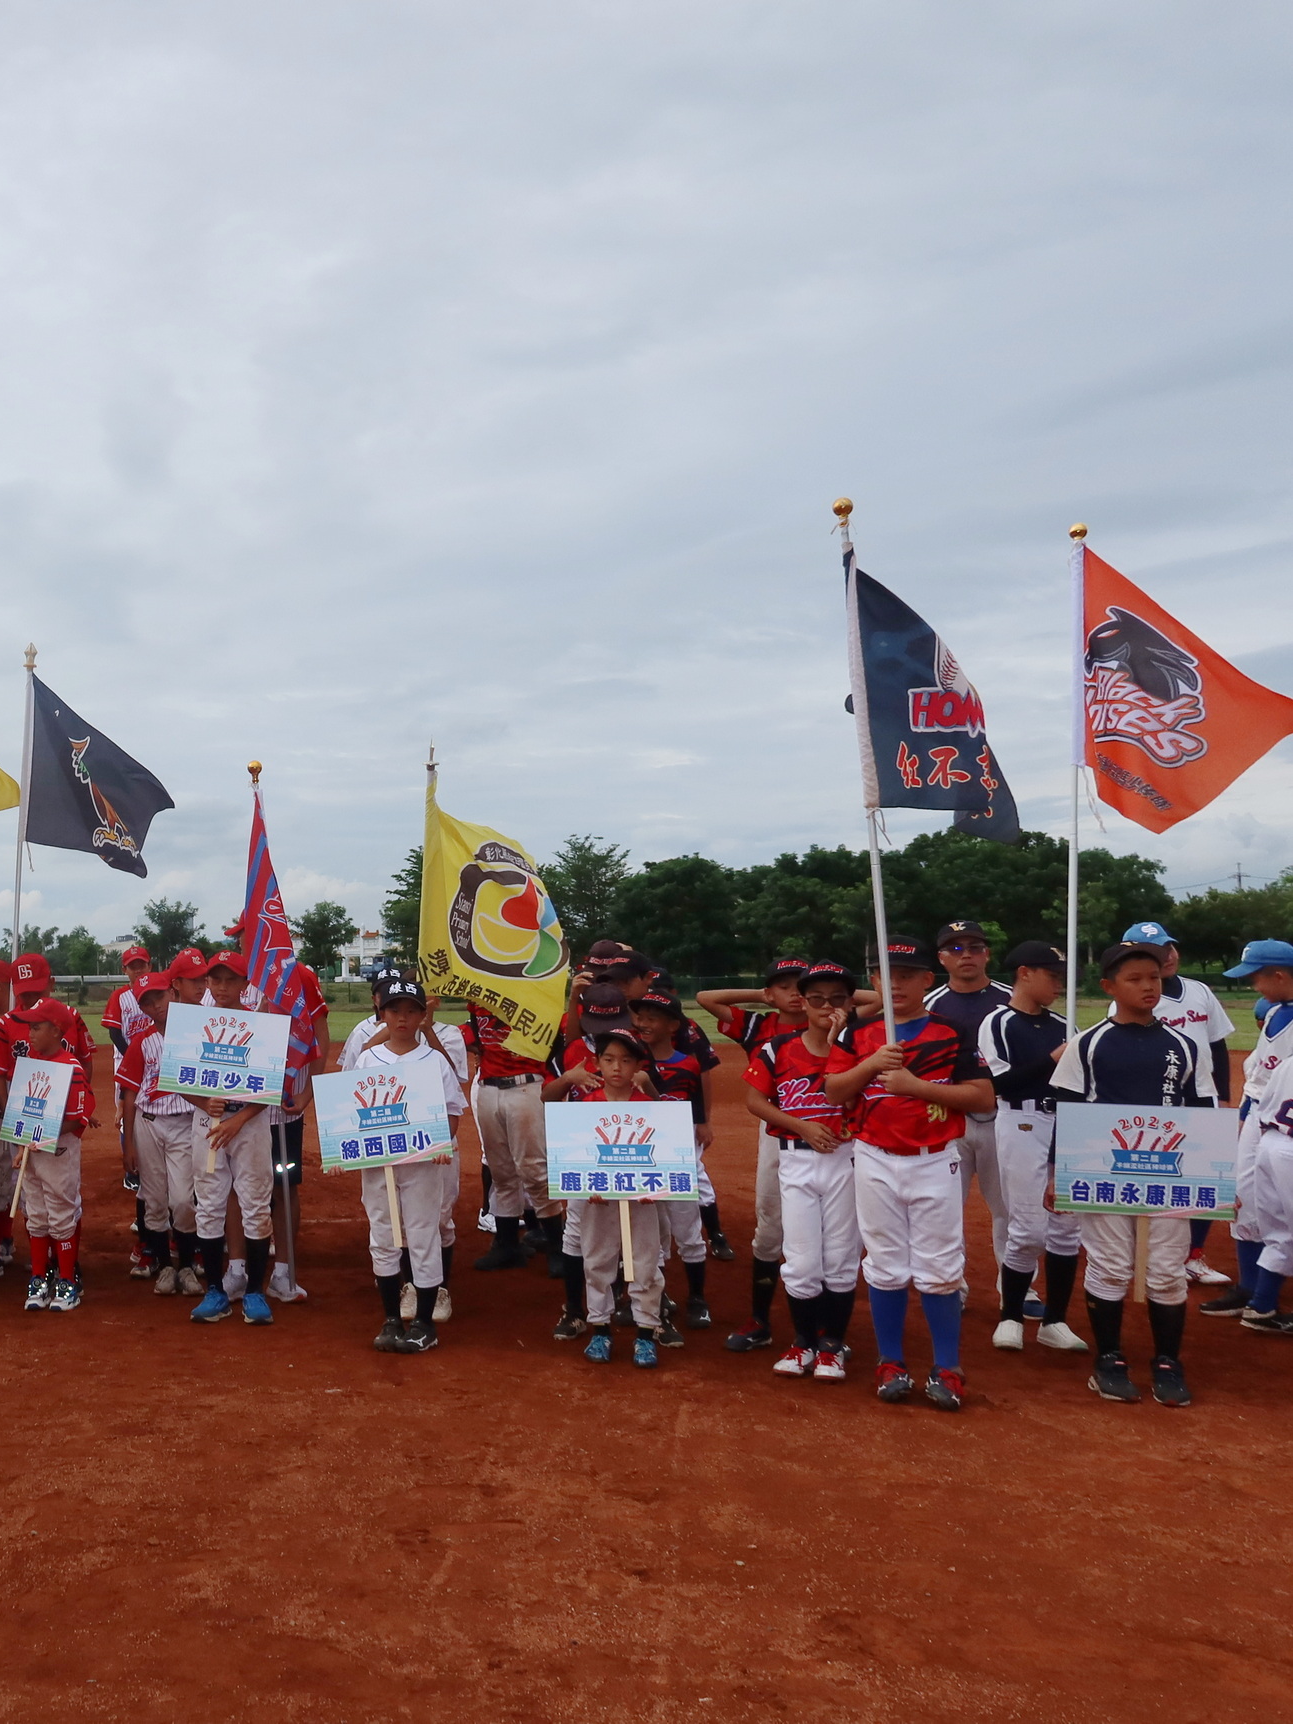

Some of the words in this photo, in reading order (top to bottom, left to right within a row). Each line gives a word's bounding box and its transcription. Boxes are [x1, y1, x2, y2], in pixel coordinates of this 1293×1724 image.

[450, 911, 470, 932] Primary
[208, 1015, 248, 1030] 2024
[178, 1065, 265, 1094] 勇靖少年
[356, 1074, 398, 1091] 2024
[598, 1113, 645, 1128] 2024
[1117, 1115, 1176, 1131] 2024
[13, 1120, 43, 1143] 東山
[340, 1130, 432, 1160] 線西國小
[560, 1171, 692, 1193] 鹿港紅不讓
[1070, 1179, 1217, 1209] 台南永康黑馬
